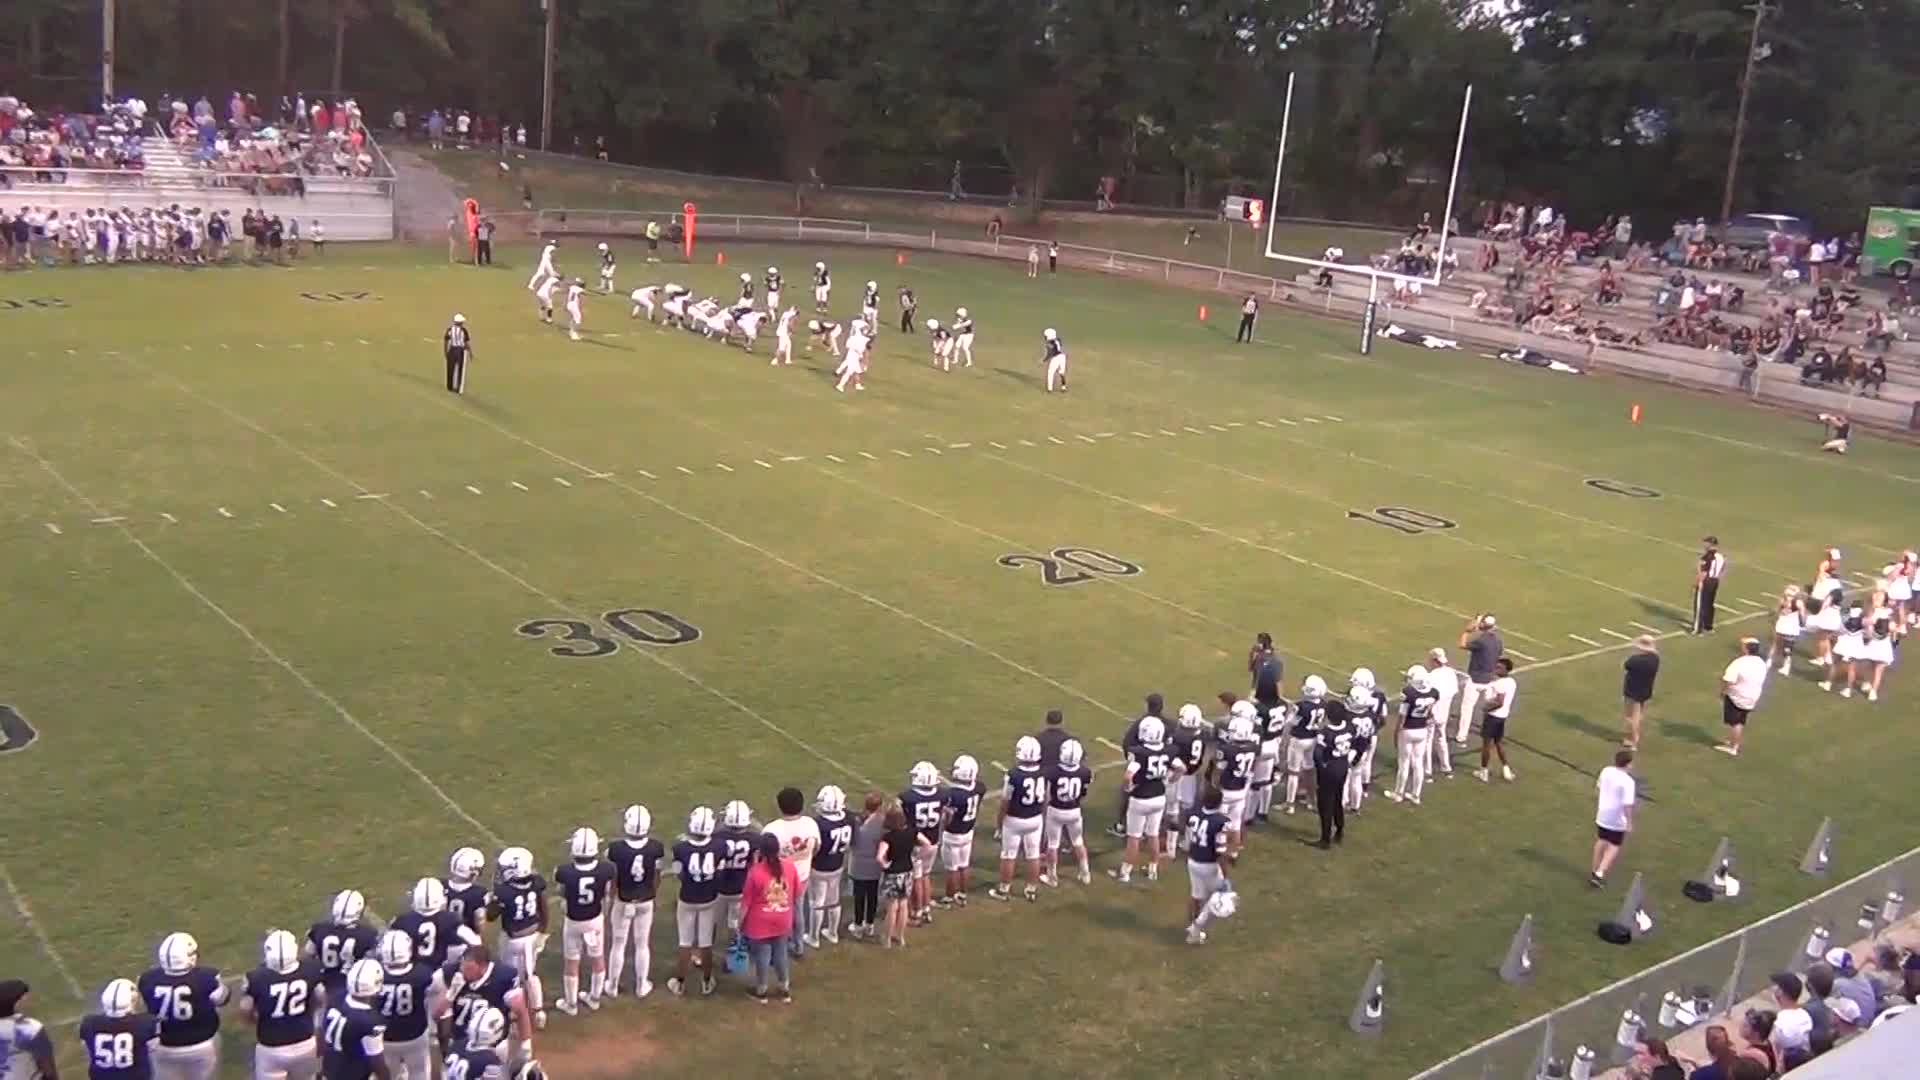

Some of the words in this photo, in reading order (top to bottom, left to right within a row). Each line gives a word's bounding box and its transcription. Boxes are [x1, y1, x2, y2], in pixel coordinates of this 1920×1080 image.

[1346, 506, 1458, 534] 10
[998, 547, 1144, 586] 20
[514, 607, 702, 657] 30
[1021, 776, 1046, 805] 34
[1056, 776, 1082, 802] 20
[915, 801, 941, 828] 55
[830, 825, 852, 854] 79
[630, 854, 645, 882] 4
[688, 852, 715, 882] 44
[578, 877, 595, 905] 5
[321, 934, 356, 974] 64
[417, 921, 437, 957] 3
[154, 985, 193, 1020] 76
[270, 979, 308, 1018] 72
[381, 983, 413, 1016] 78
[324, 1007, 347, 1052] 71
[94, 1032, 134, 1068] 58
